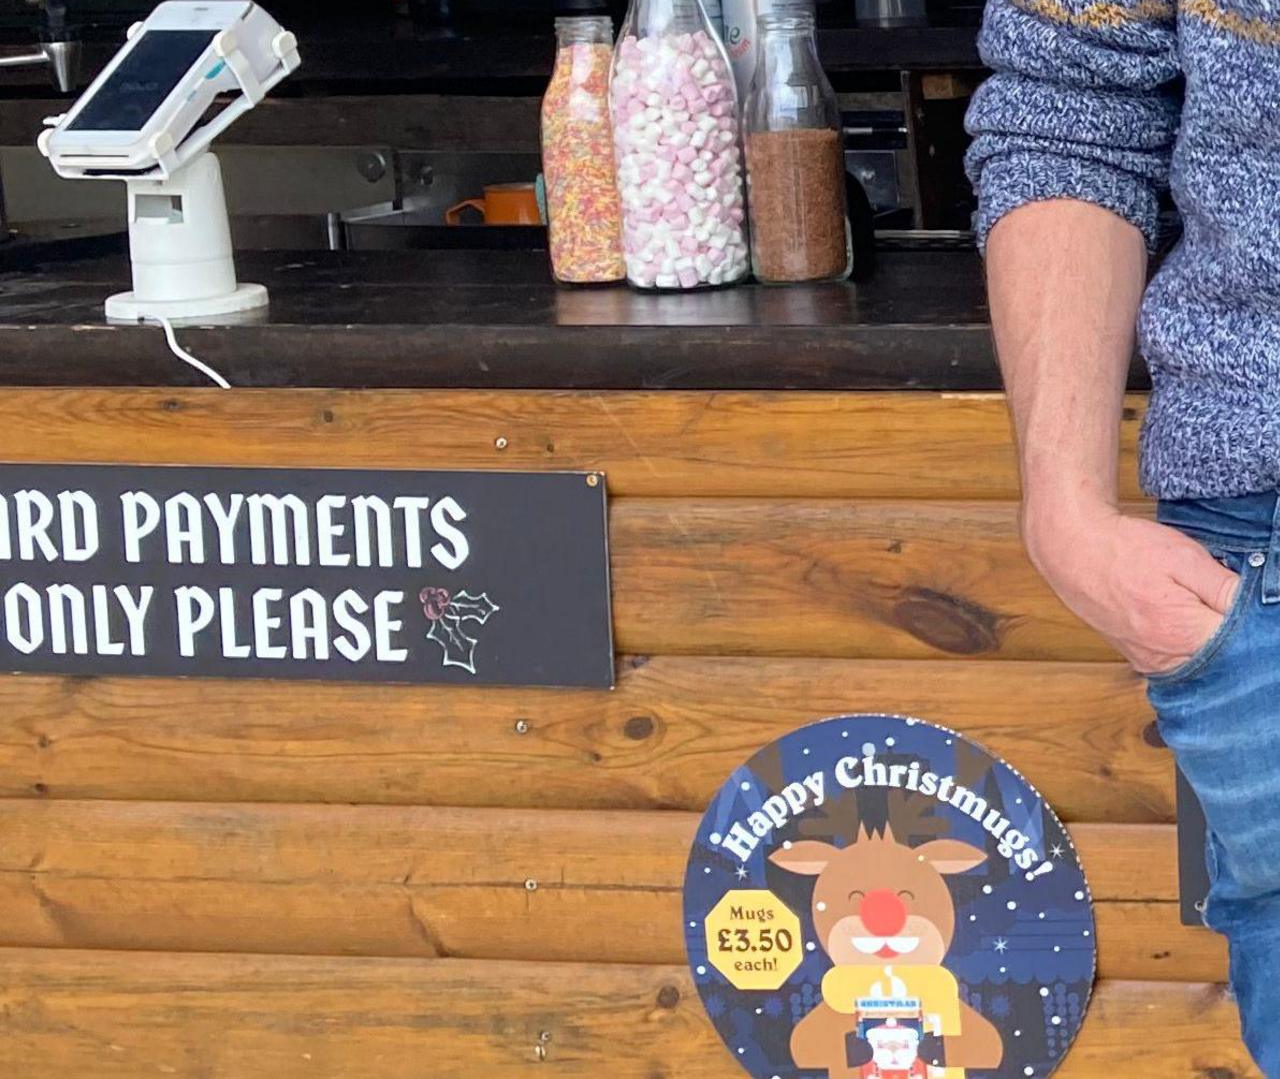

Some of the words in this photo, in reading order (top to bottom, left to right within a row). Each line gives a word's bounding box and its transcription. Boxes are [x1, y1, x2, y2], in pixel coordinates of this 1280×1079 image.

[119, 490, 471, 571] PAYMENTS
[4, 581, 154, 657] ONLY
[174, 586, 409, 664] PLEASE
[719, 769, 827, 862] Happy
[833, 752, 1054, 882] Christmugs!
[729, 905, 775, 923] Mugs
[716, 928, 794, 954] £3.50
[733, 957, 778, 973] each!
